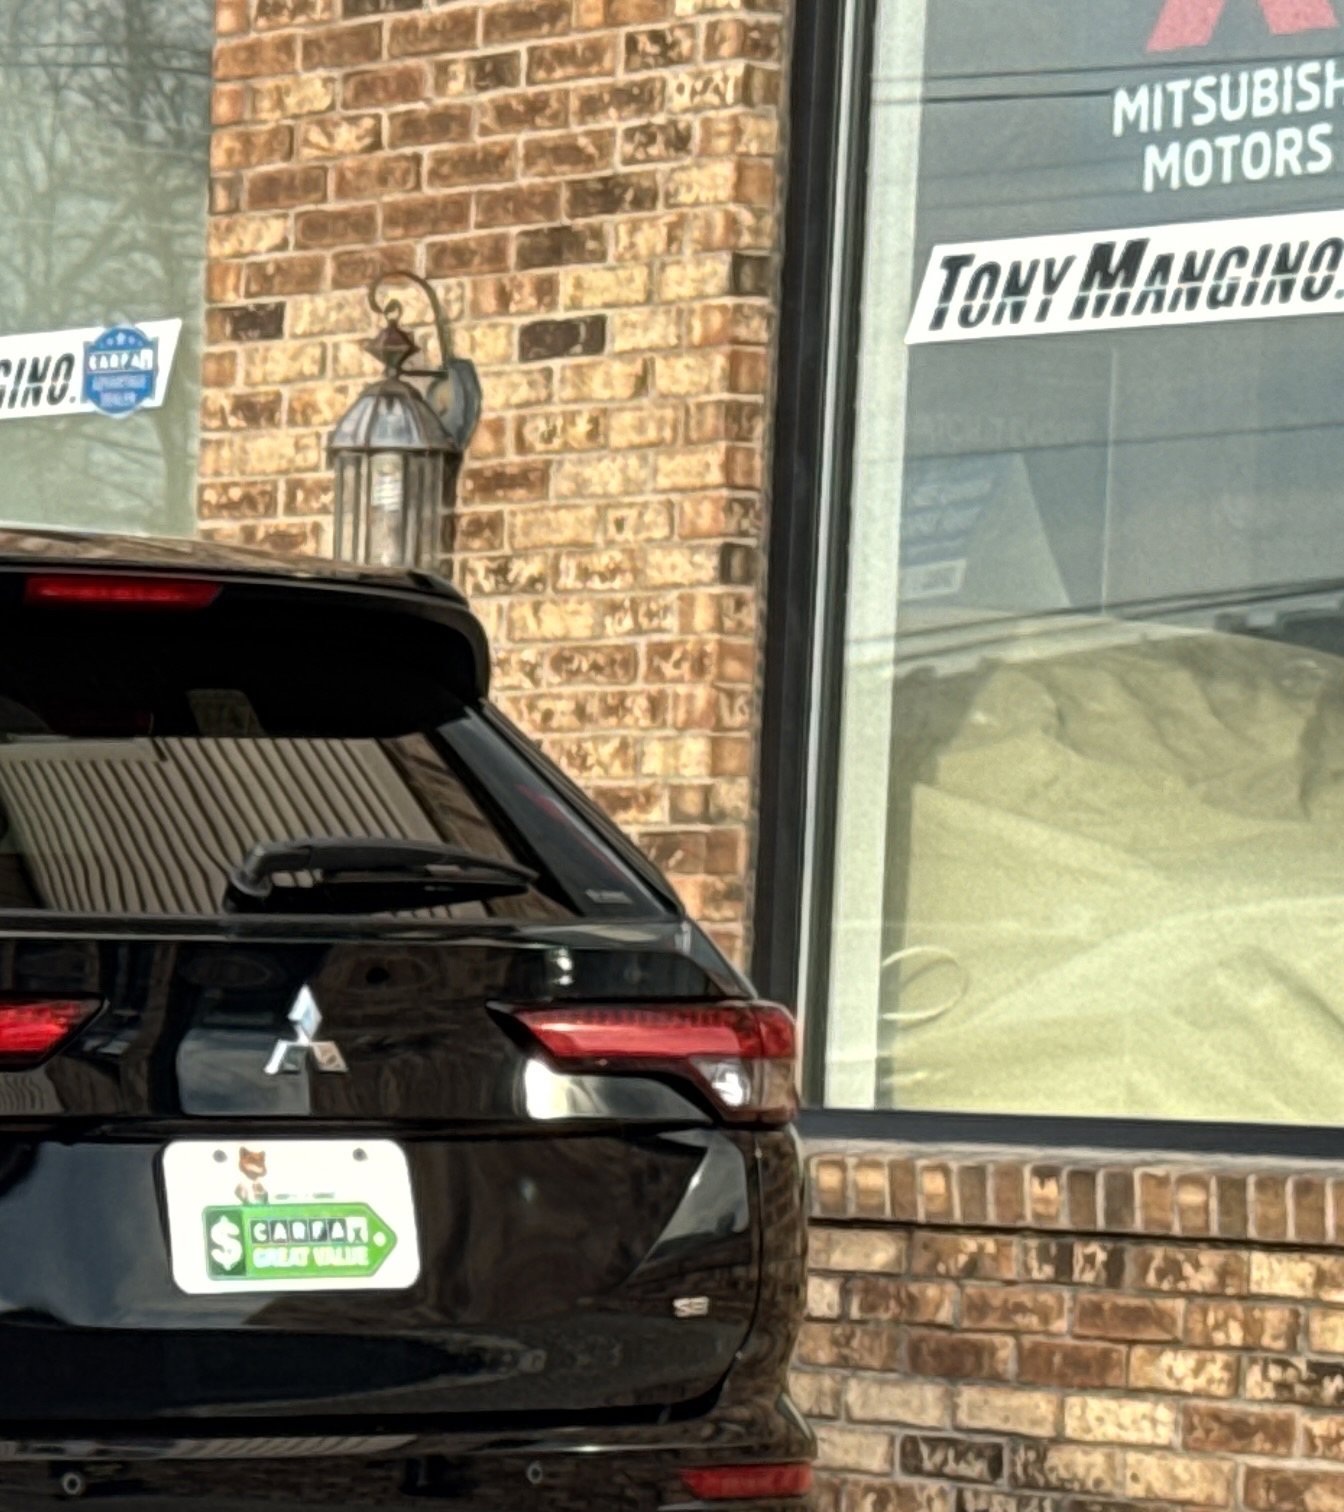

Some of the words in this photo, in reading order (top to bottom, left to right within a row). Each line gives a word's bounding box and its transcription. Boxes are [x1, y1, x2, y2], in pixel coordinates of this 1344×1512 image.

[1143, 123, 1333, 192] MOTORS
[928, 253, 1076, 331] TONY
[672, 1296, 710, 1318] SE
